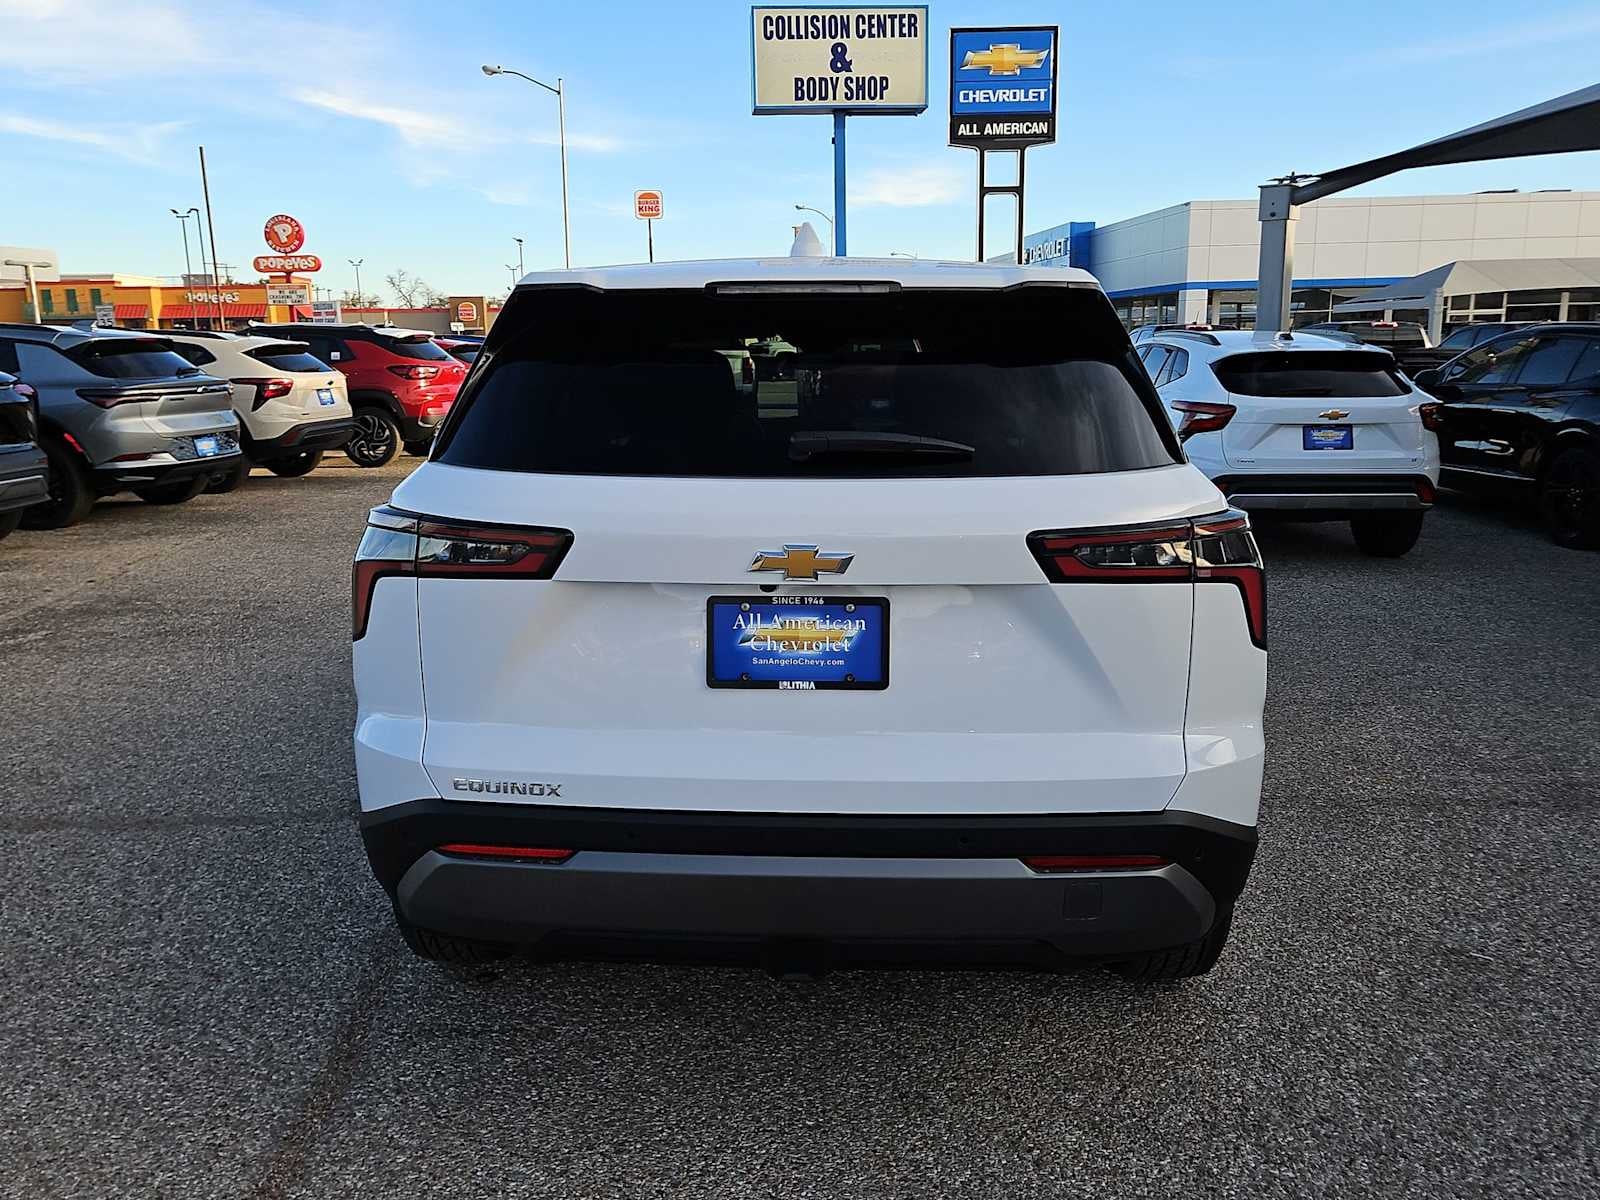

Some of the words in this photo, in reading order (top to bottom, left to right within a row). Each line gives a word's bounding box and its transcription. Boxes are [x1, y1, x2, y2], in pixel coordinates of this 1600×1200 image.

[763, 14, 850, 41] COLLISION
[855, 13, 918, 39] CENTER
[830, 42, 853, 74] &
[794, 77, 839, 101] BODY
[844, 76, 889, 100] SHOP
[959, 88, 1048, 103] CHEVROLET
[957, 123, 981, 136] ALL
[984, 122, 1048, 136] AMERICAN
[265, 216, 300, 232] LOUISIANA
[1030, 237, 1070, 263] CHEVROLET
[771, 597, 801, 605] SINCE
[804, 597, 825, 605] 1946
[732, 613, 761, 630] All
[771, 614, 866, 631] American
[750, 635, 850, 652] Chevrolet
[752, 656, 845, 666] SanAngeloChevy.com
[788, 681, 816, 690] LITHIA
[453, 778, 562, 797] EQUINOX
